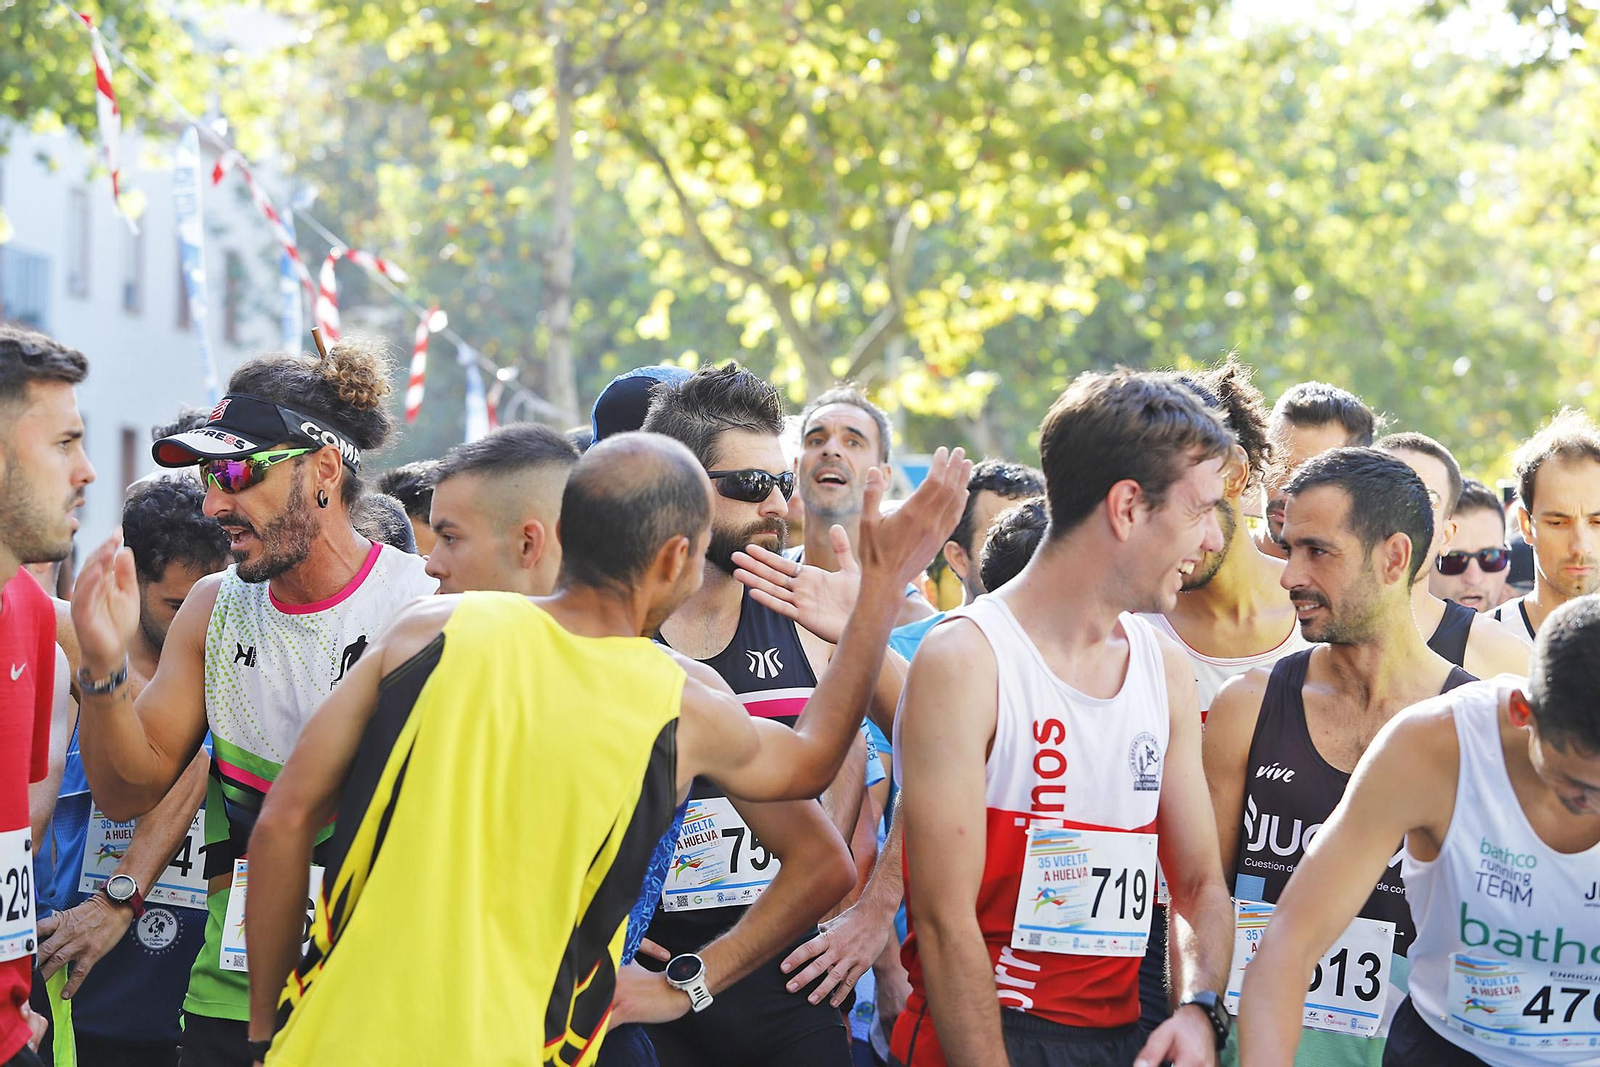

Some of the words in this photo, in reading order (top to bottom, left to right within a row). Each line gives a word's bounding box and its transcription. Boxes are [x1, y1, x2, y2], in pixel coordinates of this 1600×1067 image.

[186, 429, 246, 450] PRESS
[105, 830, 112, 840] A
[112, 829, 135, 840] HUEL
[681, 818, 716, 836] VUELTA
[676, 840, 684, 851] A
[683, 830, 719, 849] HUELVA
[721, 828, 780, 874] 75
[1480, 837, 1537, 869] bathco
[1038, 856, 1051, 869] 35
[1053, 853, 1088, 868] VUELTA
[1044, 870, 1051, 882] A
[1053, 867, 1088, 881] HUELVA
[1244, 857, 1285, 871] Cuestión
[1376, 882, 1389, 892] de
[1480, 859, 1532, 886] running
[0, 865, 30, 921] 29
[1091, 867, 1147, 921] 719
[1475, 871, 1533, 907] TEAM
[142, 910, 174, 926] bebelindo
[1245, 929, 1259, 941] 35
[1479, 975, 1519, 987] VUELTA
[1549, 971, 1600, 982] ENRIQU
[1471, 986, 1478, 995] A
[1480, 985, 1521, 997] HUELVA
